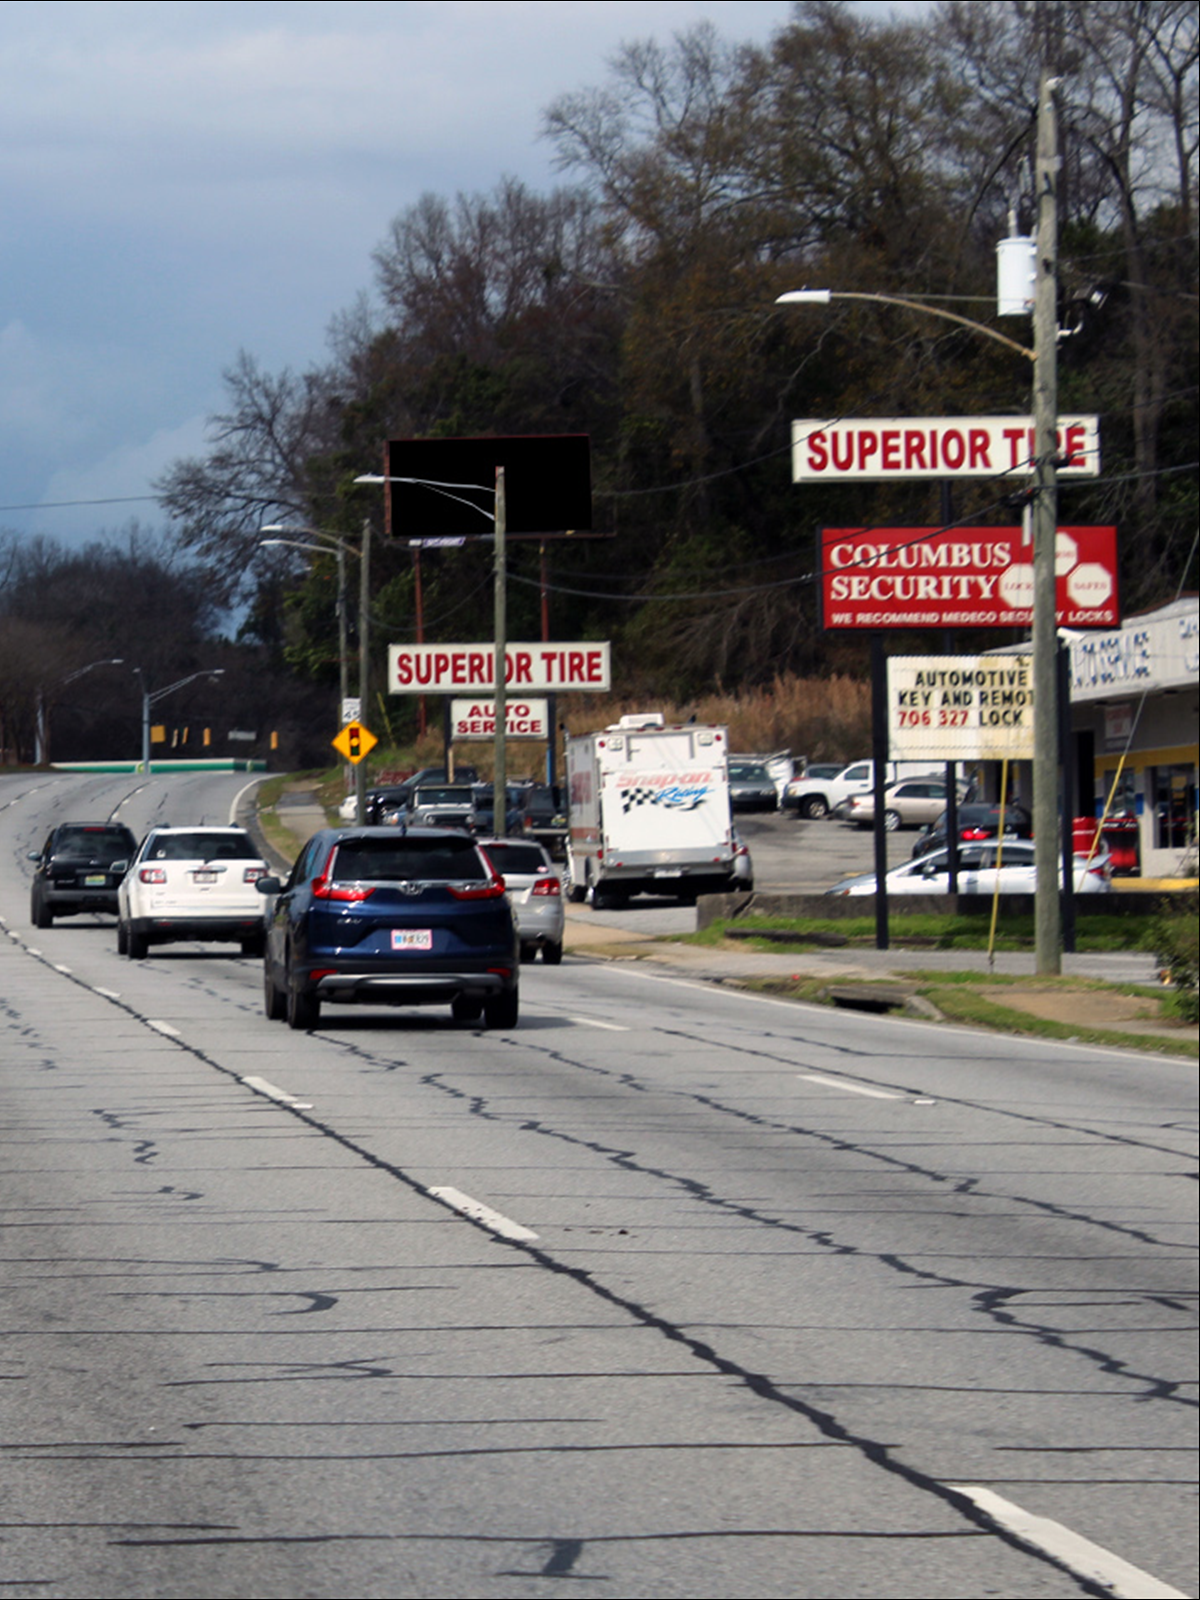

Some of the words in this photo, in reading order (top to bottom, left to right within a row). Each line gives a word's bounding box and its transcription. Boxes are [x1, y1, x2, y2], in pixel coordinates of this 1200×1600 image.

[807, 428, 992, 472] SUPERIOR
[1003, 427, 1087, 468] TIE
[829, 542, 1011, 570] COLUMBUS
[830, 574, 997, 601] SECURITY
[831, 612, 853, 624] WE
[856, 611, 940, 624] RECOMMEND
[941, 610, 997, 623] MEDECO
[999, 610, 1064, 623] SECUY
[1068, 610, 1114, 622] LOCKS
[541, 651, 603, 683] TIRE
[915, 670, 1028, 686] AUTOMOTIVE
[898, 690, 932, 706] KEY
[941, 690, 973, 706] AND
[979, 690, 1035, 706] REMOT
[468, 704, 531, 718] AUTO
[898, 710, 931, 726] 706
[939, 710, 969, 726] 327
[979, 710, 1023, 726] LOCK
[457, 720, 542, 733] SERICE
